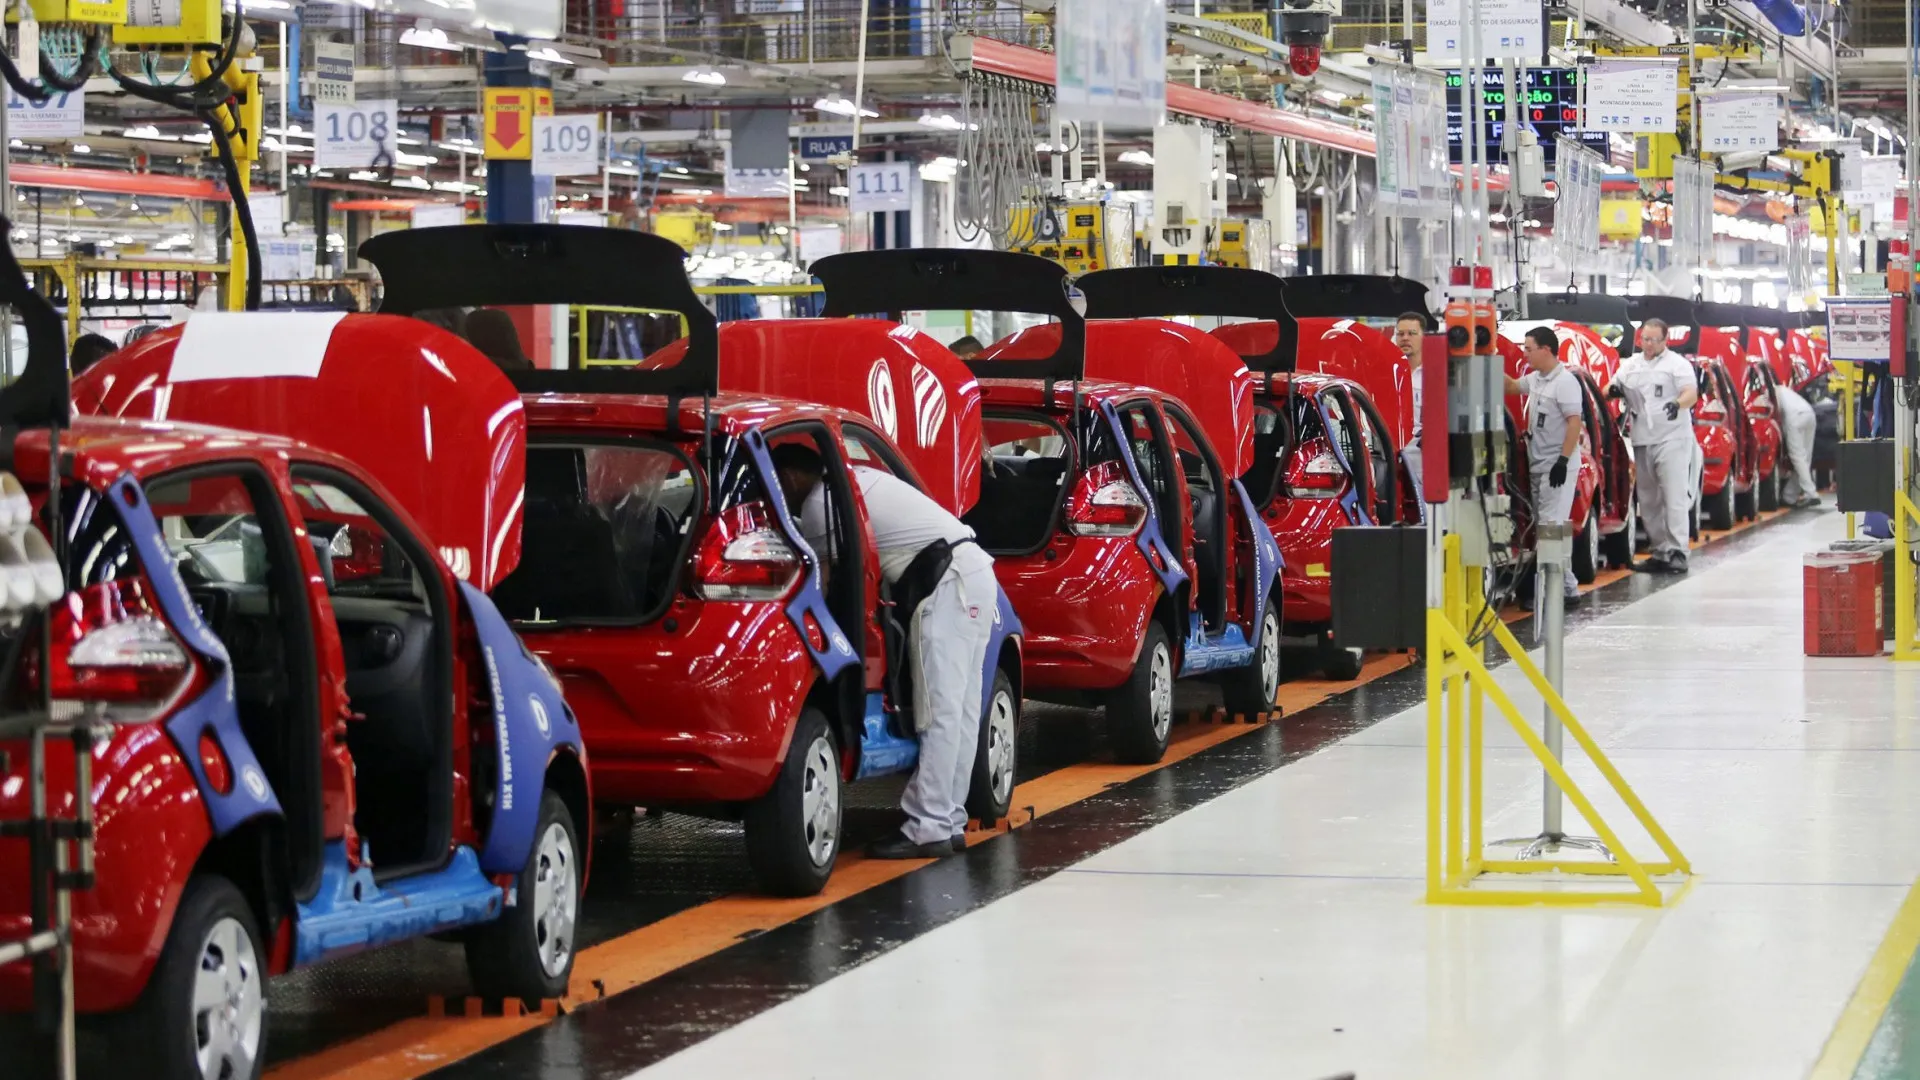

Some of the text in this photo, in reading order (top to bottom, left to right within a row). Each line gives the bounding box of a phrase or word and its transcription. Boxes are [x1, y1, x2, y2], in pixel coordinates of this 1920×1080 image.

[1500, 18, 1539, 26] SEGURANÇA
[1663, 46, 1690, 55] KNIGH
[1470, 73, 1504, 85] FNAL
[1481, 89, 1553, 105] Proução
[326, 111, 389, 142] 108
[541, 125, 592, 153] 109
[809, 141, 837, 153] RUA
[856, 172, 904, 194] 111
[486, 645, 513, 811] PROTEÇÃO PARALAMA X1H
